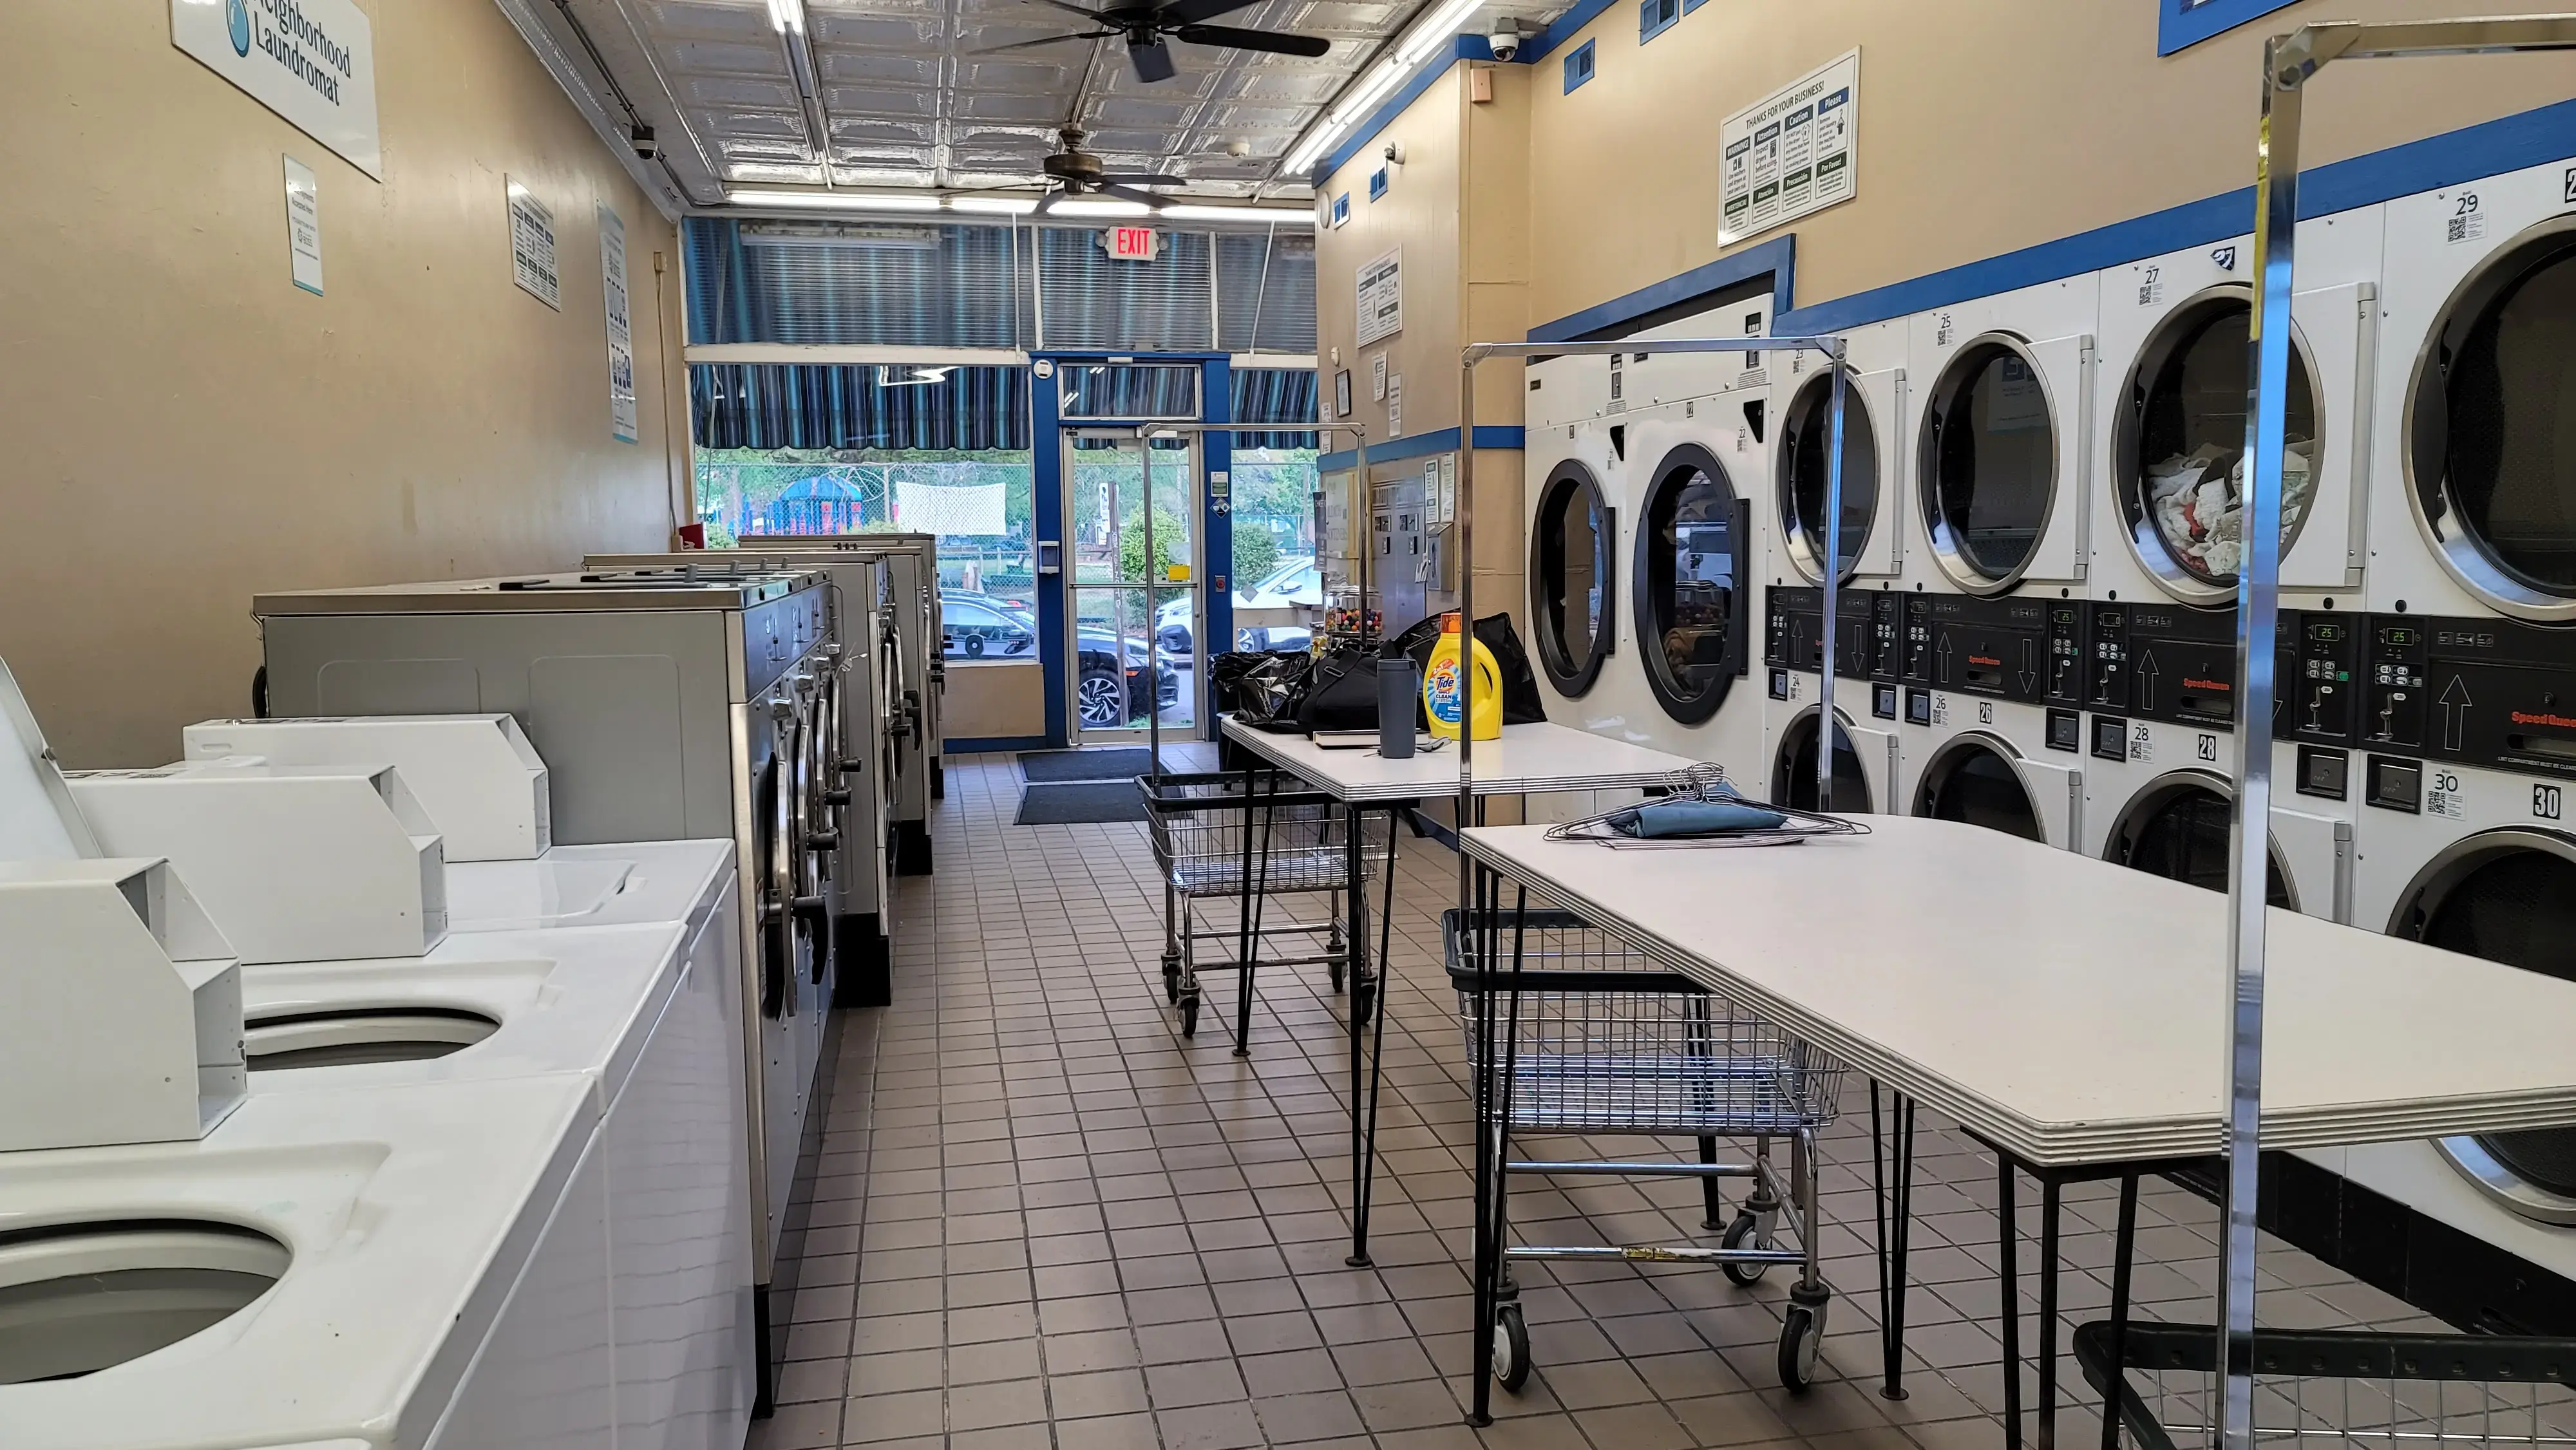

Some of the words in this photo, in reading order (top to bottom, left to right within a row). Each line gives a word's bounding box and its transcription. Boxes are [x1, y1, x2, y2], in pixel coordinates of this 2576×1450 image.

[243, 0, 351, 79] eighborhood
[254, 10, 340, 107] Laundromat
[1746, 110, 1766, 130] THANKS
[1767, 104, 1778, 119] FOR
[1778, 97, 1794, 113] YOUR
[1794, 80, 1824, 105] BUSINESS!
[1824, 94, 1842, 109] Please
[1789, 111, 1808, 126] Caution
[1756, 126, 1778, 143] Attention
[1727, 138, 1749, 157] WARNING!
[1756, 144, 1768, 156] Inspect
[1755, 155, 1766, 166] dryers
[1821, 164, 1829, 173] Por
[1828, 156, 1842, 170] Favor!
[1755, 164, 1766, 174] before
[1786, 172, 1808, 187] Precaución
[2566, 169, 2576, 202] 2
[2455, 194, 2479, 216] 29
[1117, 229, 1150, 256] EXIT
[2213, 247, 2233, 268] 27
[2145, 267, 2159, 285] 27
[1940, 315, 1951, 329] 25
[1795, 349, 1803, 359] 23
[1739, 428, 1746, 438] 22
[2062, 613, 2069, 621] 25
[2321, 628, 2332, 637] 25
[2393, 632, 2405, 642] 25
[1968, 655, 1984, 664] Speed
[1436, 676, 1455, 691] Tide
[1792, 676, 1801, 687] 24
[2183, 678, 2206, 688] Speed
[2206, 680, 2230, 691] Queen
[1935, 697, 1946, 710] 26
[1980, 702, 1991, 723] 26
[2512, 711, 2548, 724] Speed
[2548, 714, 2576, 728] Quee
[2134, 726, 2149, 741] 28
[2199, 735, 2215, 760] 28
[2508, 757, 2540, 767] COMPARTMENT
[2434, 773, 2459, 793] 30
[2534, 787, 2559, 818] 30
